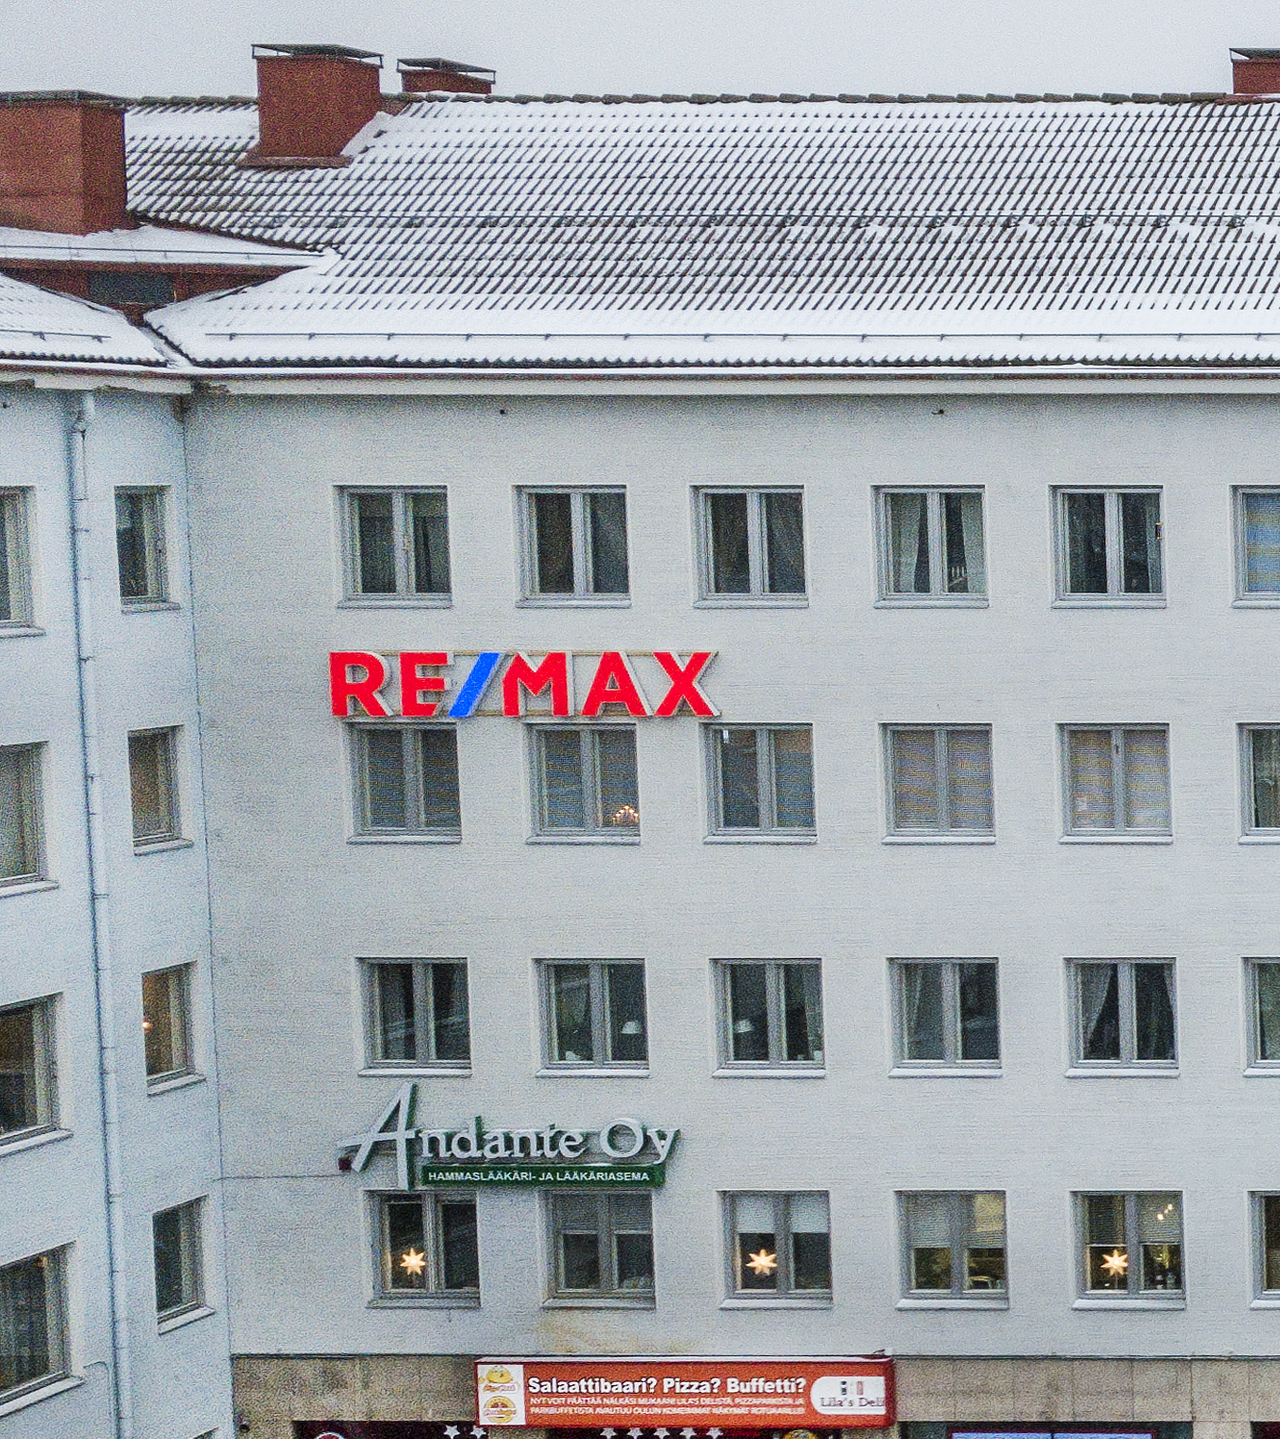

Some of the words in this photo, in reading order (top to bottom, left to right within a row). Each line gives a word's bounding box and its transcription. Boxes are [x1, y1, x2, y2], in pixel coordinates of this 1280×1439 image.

[329, 651, 717, 717] RE/MAX
[342, 1082, 584, 1190] Andante
[600, 1117, 681, 1164] Oy
[428, 1170, 536, 1182] HAMMASLÄÄKÄRI-
[539, 1170, 554, 1182] JA
[556, 1170, 650, 1182] LÄÄKÄRIASEMA
[528, 1377, 657, 1393] Salaattibaari?
[663, 1377, 720, 1393] Pizza?
[727, 1377, 807, 1393] Buffetti?
